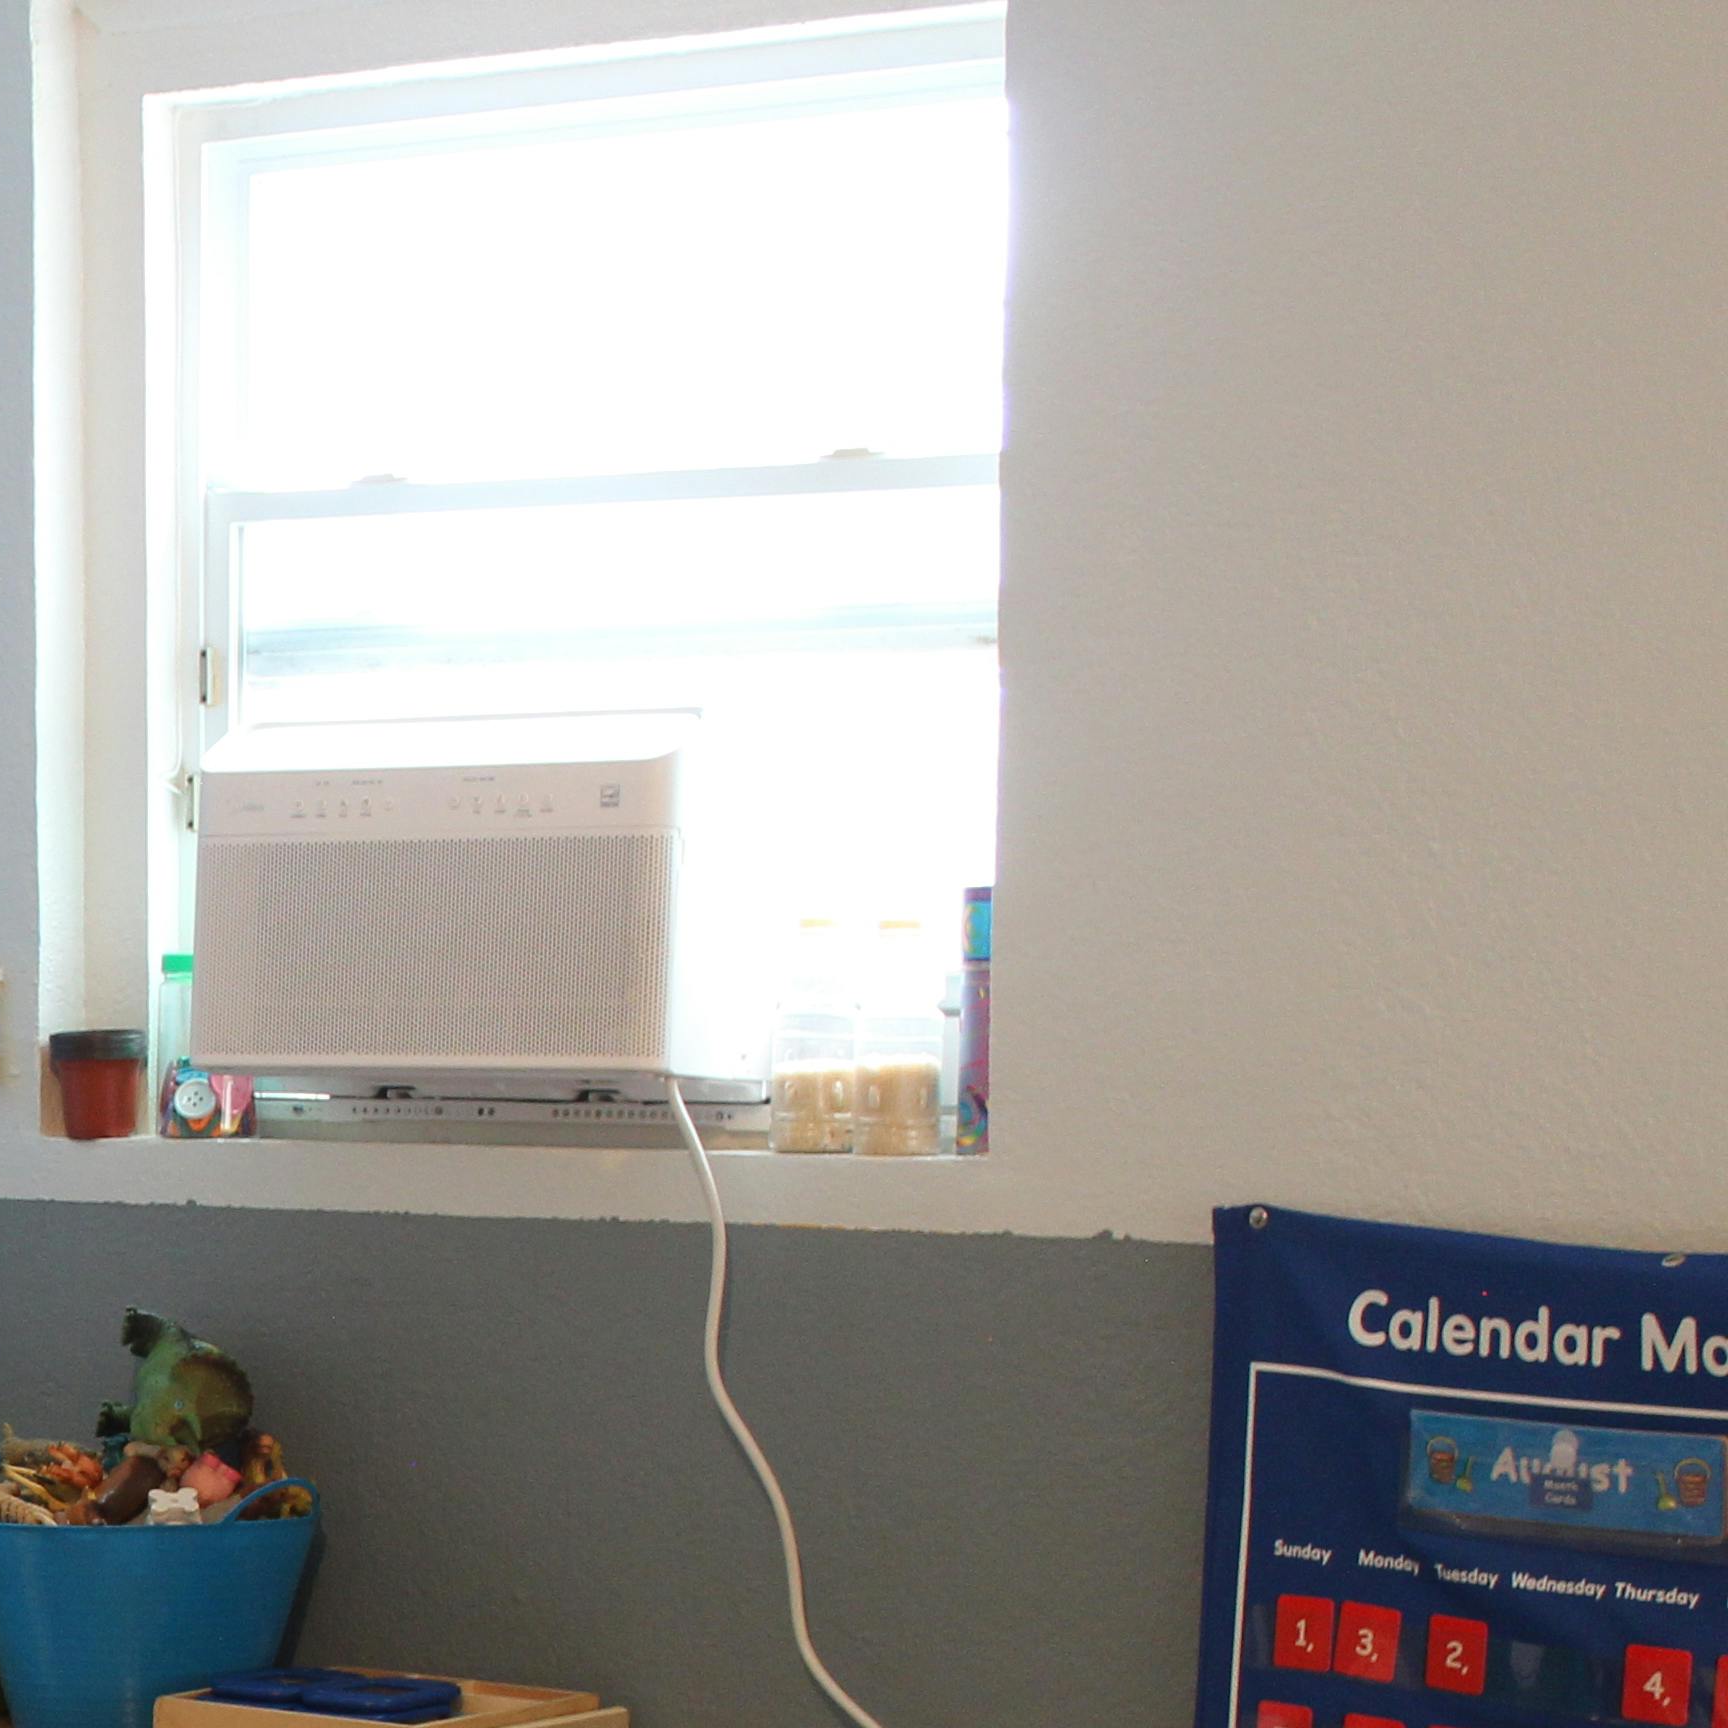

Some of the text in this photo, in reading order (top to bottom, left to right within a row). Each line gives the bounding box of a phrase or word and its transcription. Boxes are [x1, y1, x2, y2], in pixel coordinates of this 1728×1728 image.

[1347, 1289, 1622, 1368] Calendar
[1273, 1539, 1700, 1610] Sunday Monday Tuesday Wednesday Thursday
[1295, 1619, 1671, 1707] 1, 3, 2, 4,
